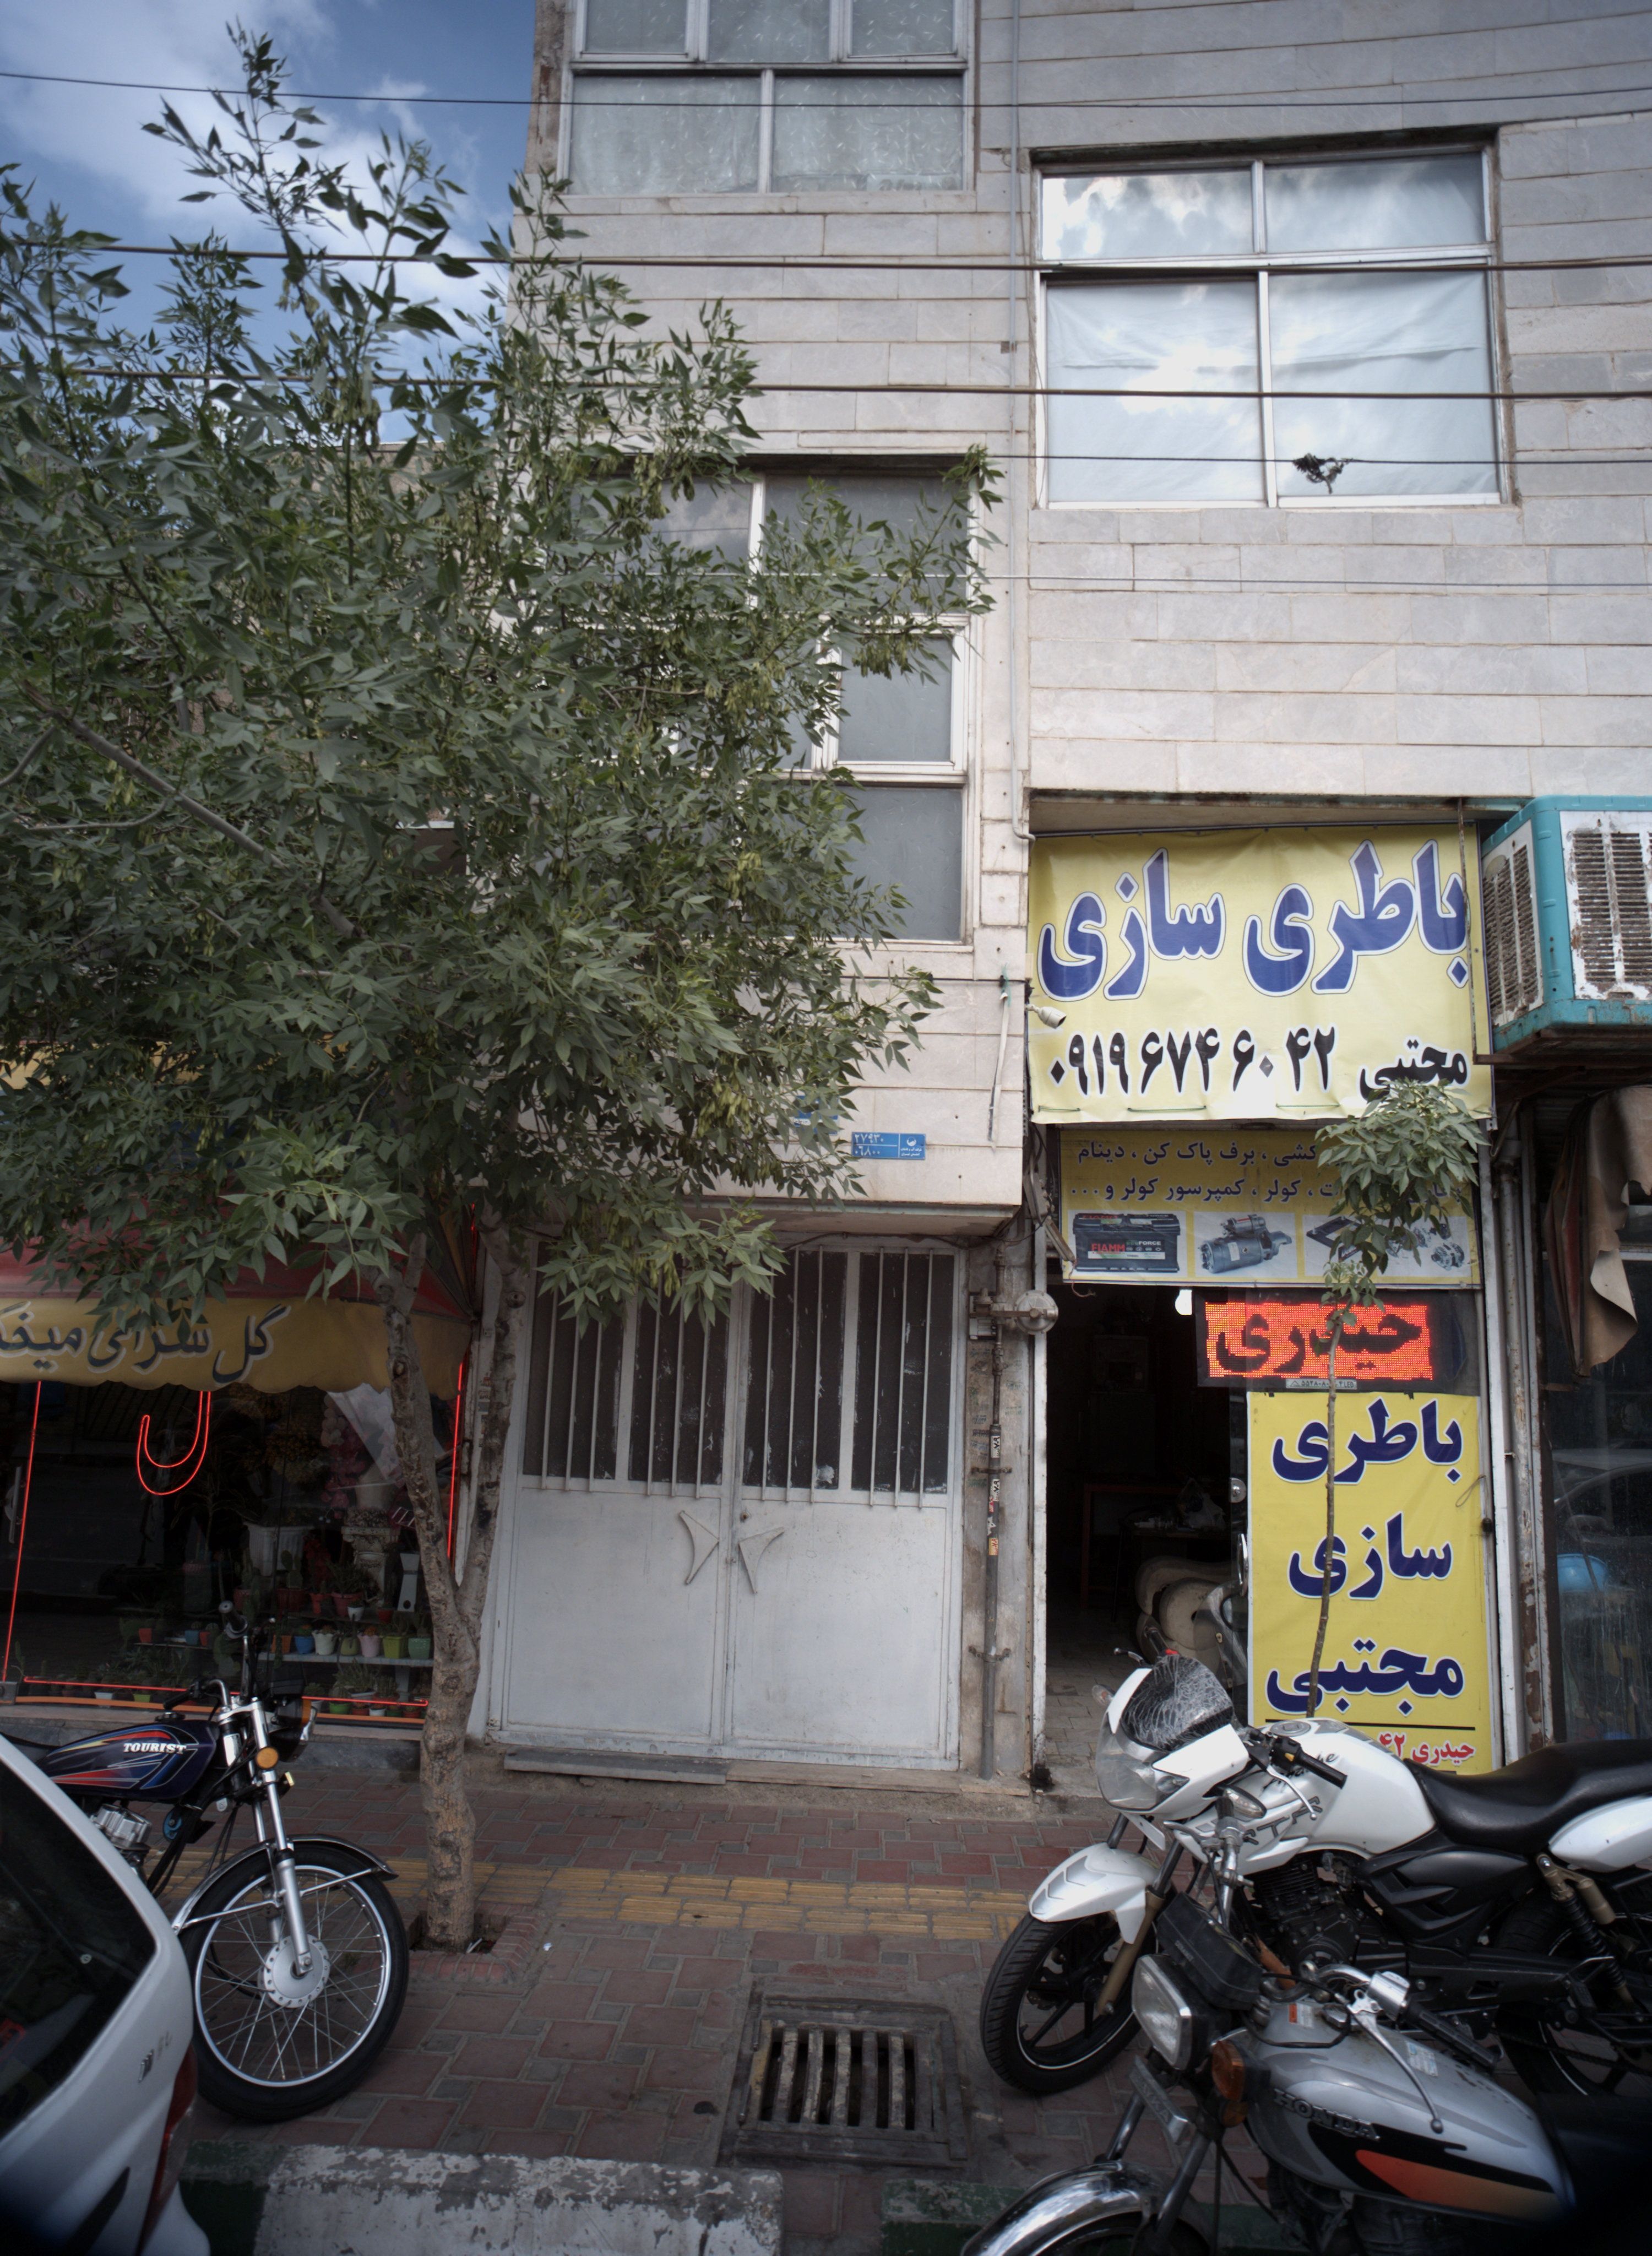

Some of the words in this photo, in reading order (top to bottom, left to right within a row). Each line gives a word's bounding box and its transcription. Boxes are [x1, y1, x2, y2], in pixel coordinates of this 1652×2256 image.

[1039, 848, 1226, 1000] سازی
[1245, 840, 1469, 996] باطری
[1078, 1141, 1124, 1164] دینام
[1144, 1142, 1170, 1165] کن
[1177, 1142, 1213, 1165] پاک
[1219, 1142, 1254, 1165] برف
[1120, 1177, 1159, 1201] کولر
[1165, 1179, 1245, 1202] کمپرسور
[1264, 1179, 1301, 1202] کولر
[1091, 1243, 1126, 1252] FIAMM
[212, 1304, 290, 1384] گل
[1216, 1314, 1422, 1373] حیدری
[1272, 1397, 1463, 1484] باطری
[1289, 1512, 1453, 1599] سازی
[1267, 1639, 1465, 1715] مجتبی
[123, 1742, 187, 1755] TOURIST
[1412, 1742, 1475, 1764] حیدری
[1274, 2087, 1381, 2141] HONDA
